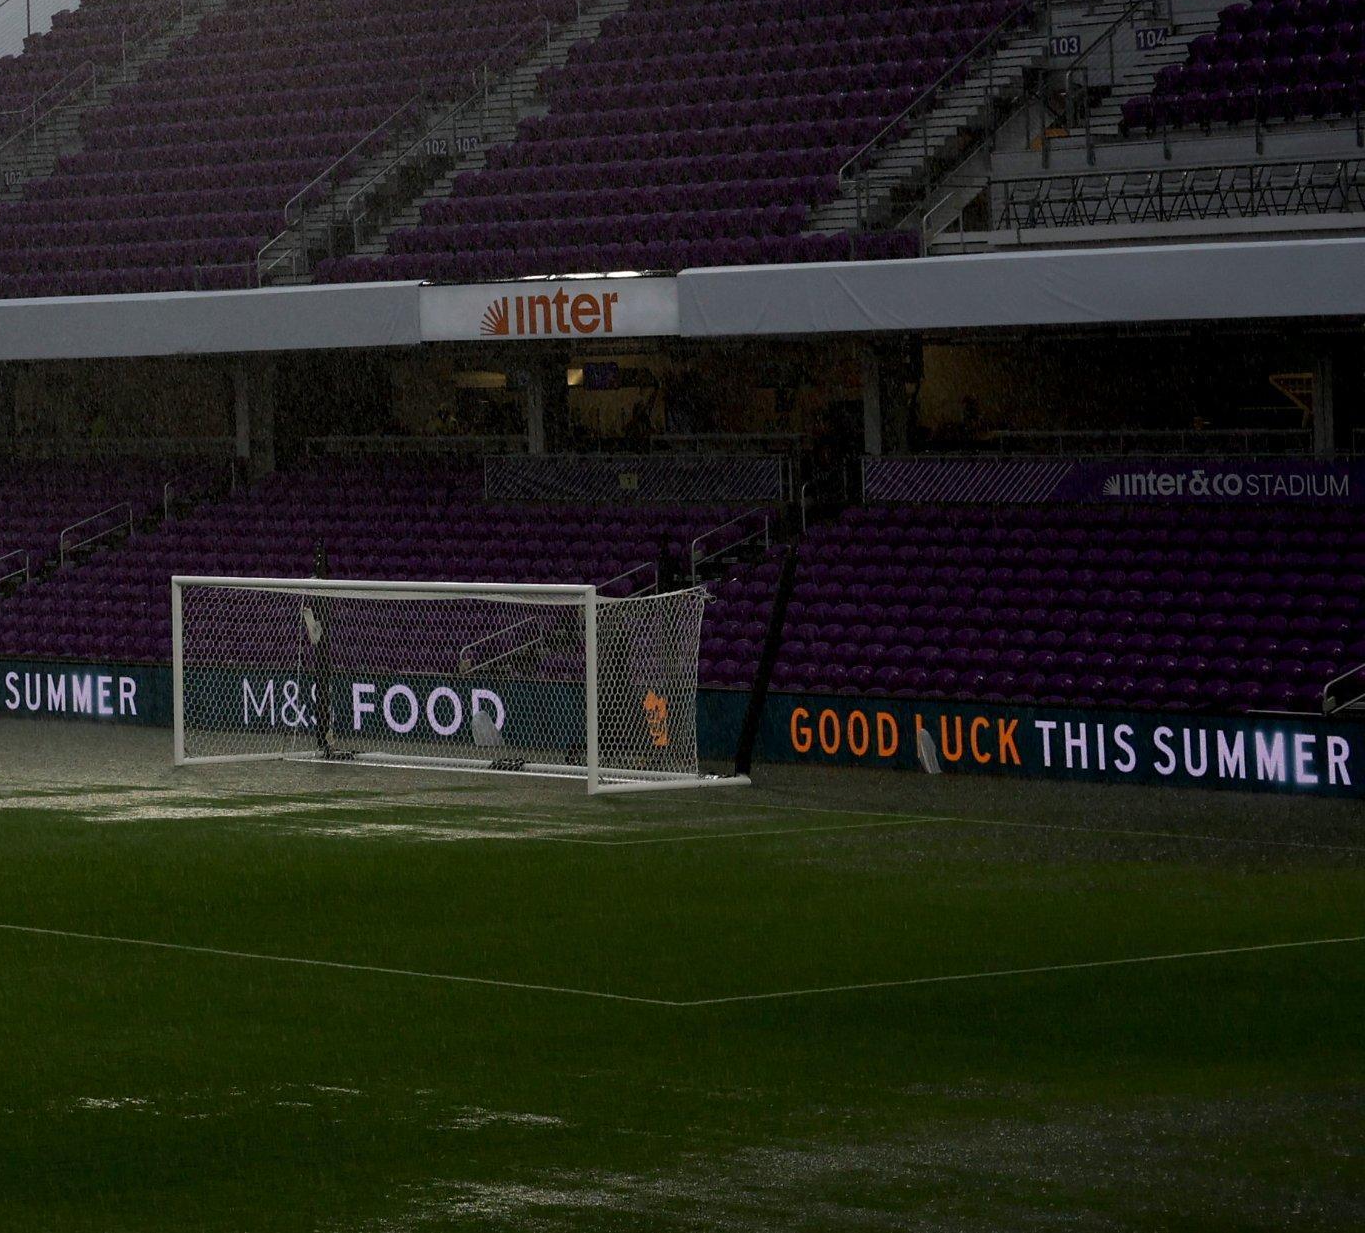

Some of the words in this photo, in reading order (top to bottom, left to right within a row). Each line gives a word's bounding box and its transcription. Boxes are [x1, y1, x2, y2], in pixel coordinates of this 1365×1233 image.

[1051, 37, 1078, 55] 103
[1137, 30, 1167, 48] 104
[425, 139, 447, 155] 102
[456, 137, 478, 152] 103
[515, 286, 618, 335] inter
[1245, 474, 1350, 497] STADIUM
[5, 671, 138, 717] SUMMER
[352, 683, 505, 736] FOOD
[789, 706, 899, 755] GOOD
[1035, 720, 1137, 773] THIS
[1153, 725, 1352, 785] SUMMER
